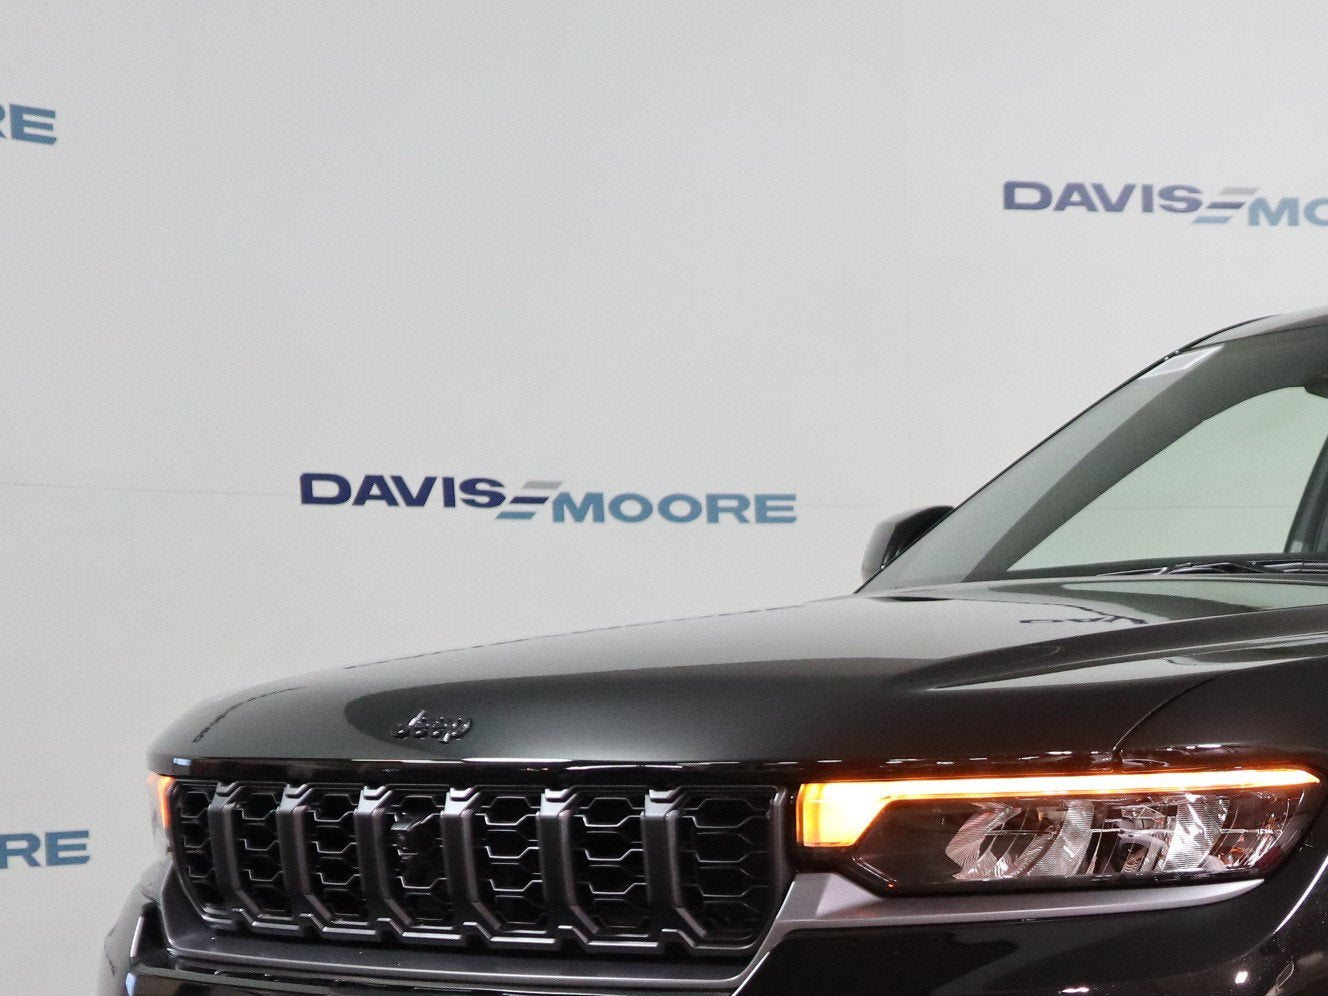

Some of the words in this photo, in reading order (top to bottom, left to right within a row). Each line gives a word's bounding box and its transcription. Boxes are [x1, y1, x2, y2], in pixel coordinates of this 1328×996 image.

[0, 102, 58, 146] E
[1002, 180, 1205, 215] DAVIS
[298, 471, 508, 510] DAVIS
[551, 491, 799, 525] MOORE
[393, 709, 474, 744] Jeep
